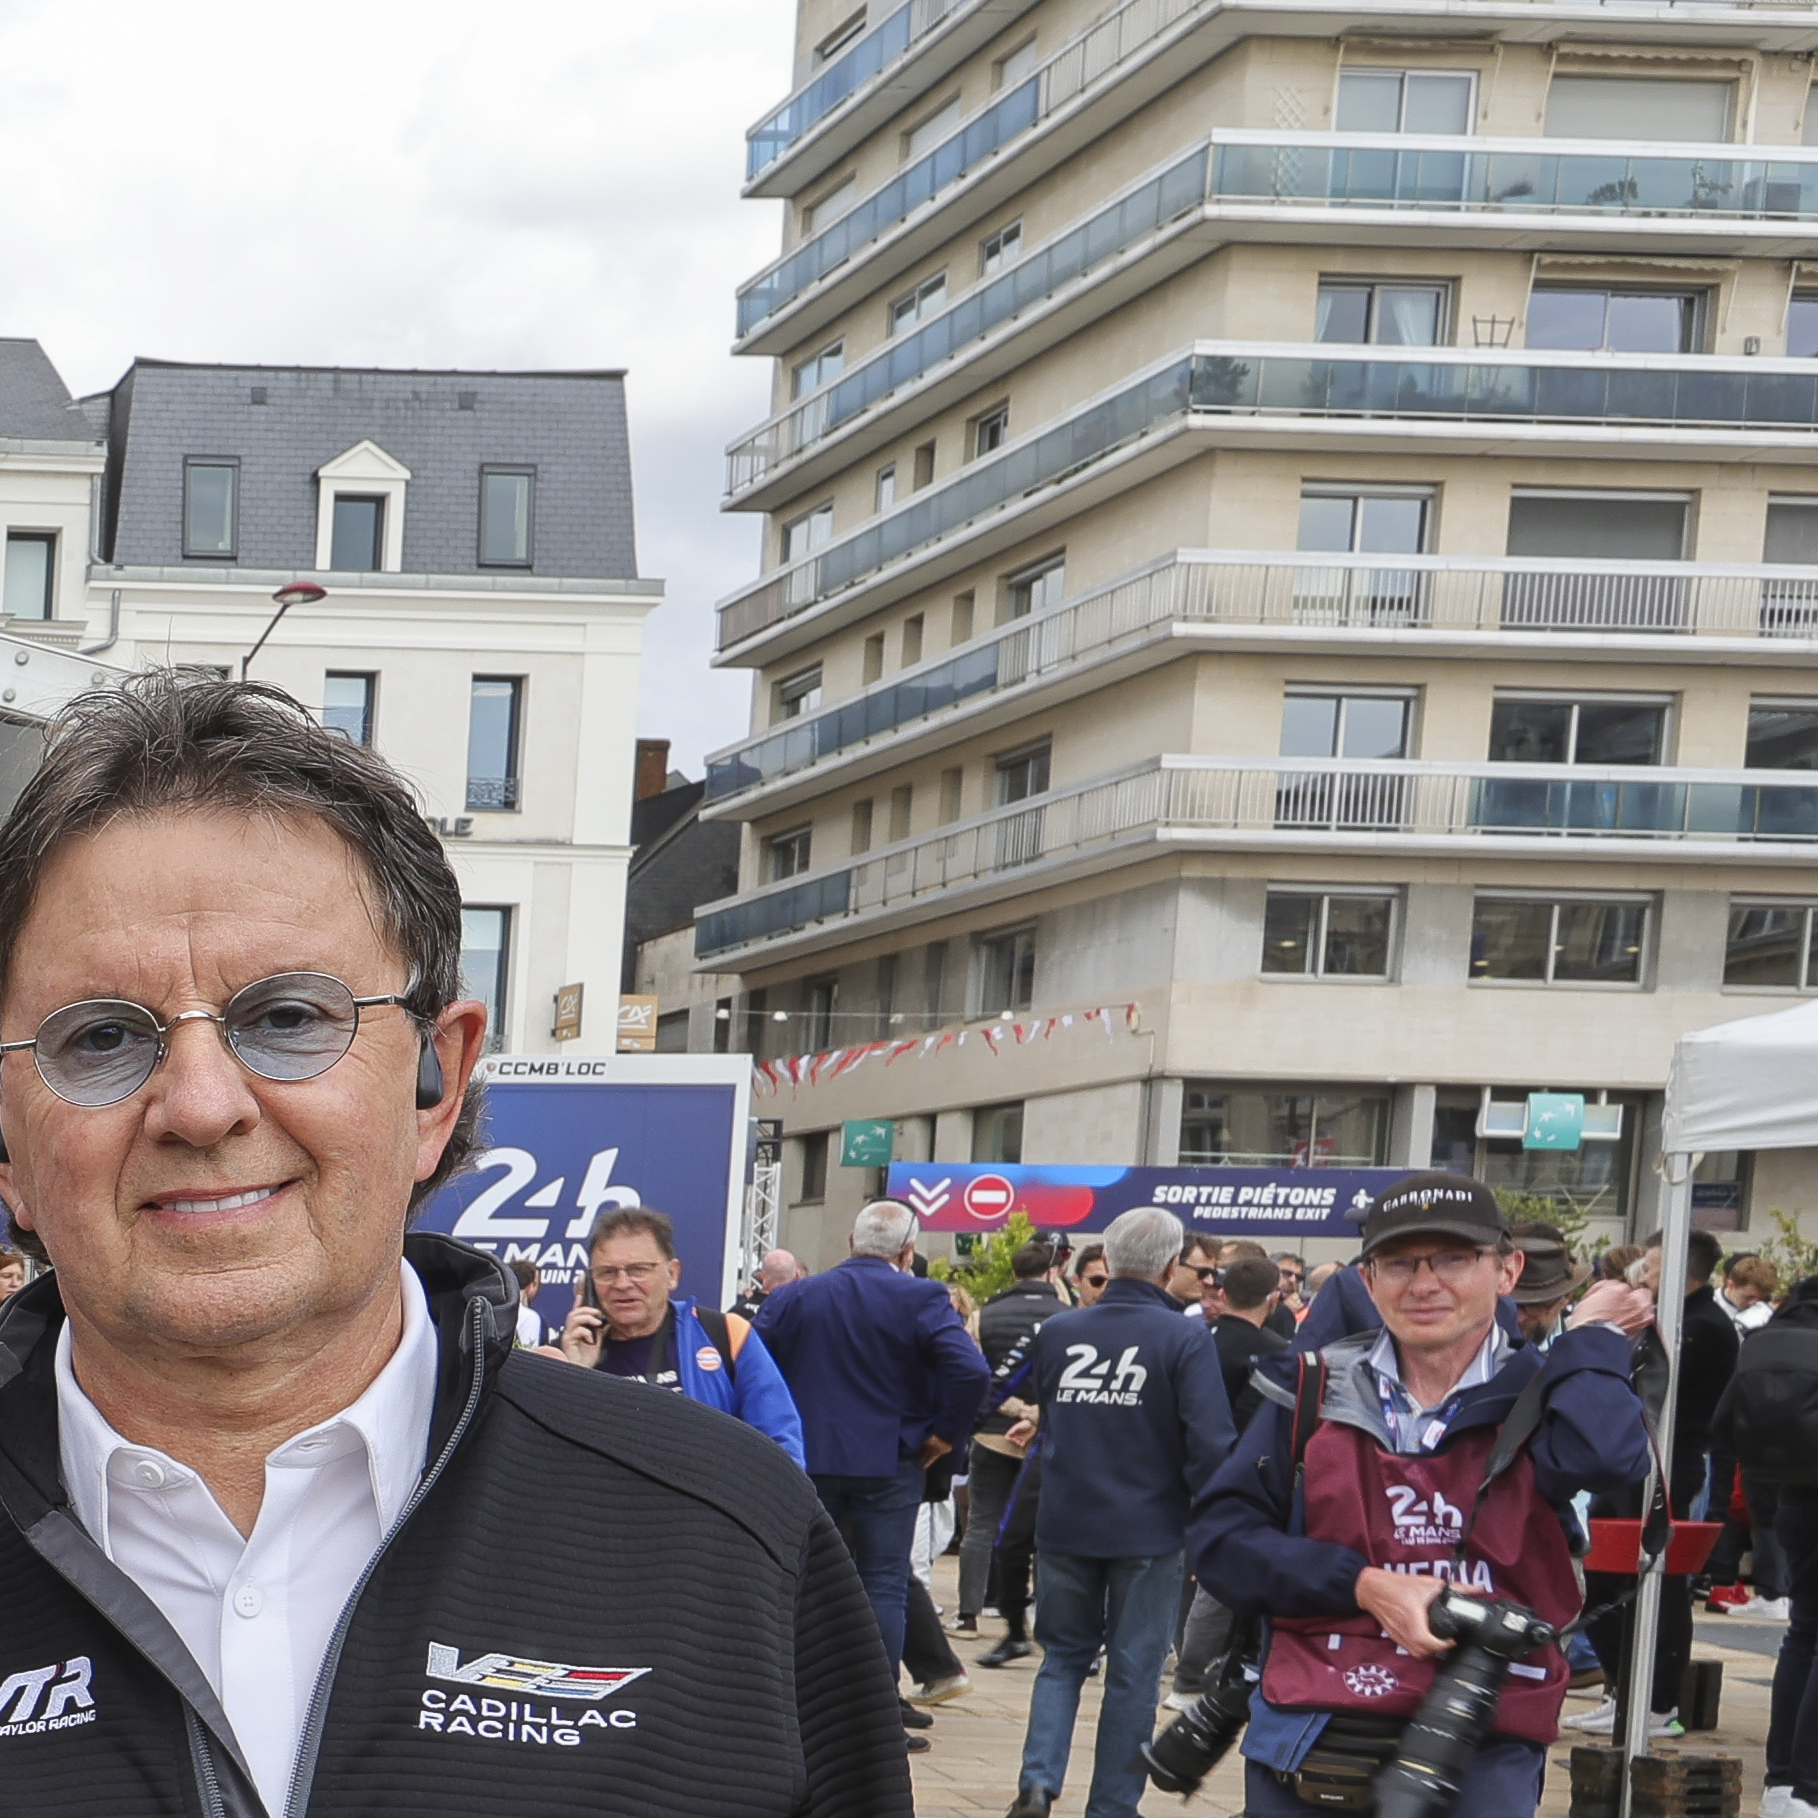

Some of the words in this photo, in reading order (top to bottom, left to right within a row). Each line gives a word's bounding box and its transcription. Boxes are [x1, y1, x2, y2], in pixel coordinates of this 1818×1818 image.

[1152, 1185, 1234, 1204] SORTIE
[1237, 1182, 1337, 1205] PIÉTONS
[1192, 1206, 1292, 1219] PEDESTRIANS
[1294, 1207, 1331, 1220] EXIT
[1059, 1343, 1148, 1392] 24h
[1056, 1389, 1075, 1403] LE
[1385, 1484, 1463, 1528] 24h
[47, 1709, 97, 1731] RACING
[421, 1689, 637, 1729] CADILLAC
[418, 1710, 582, 1747] RACING
